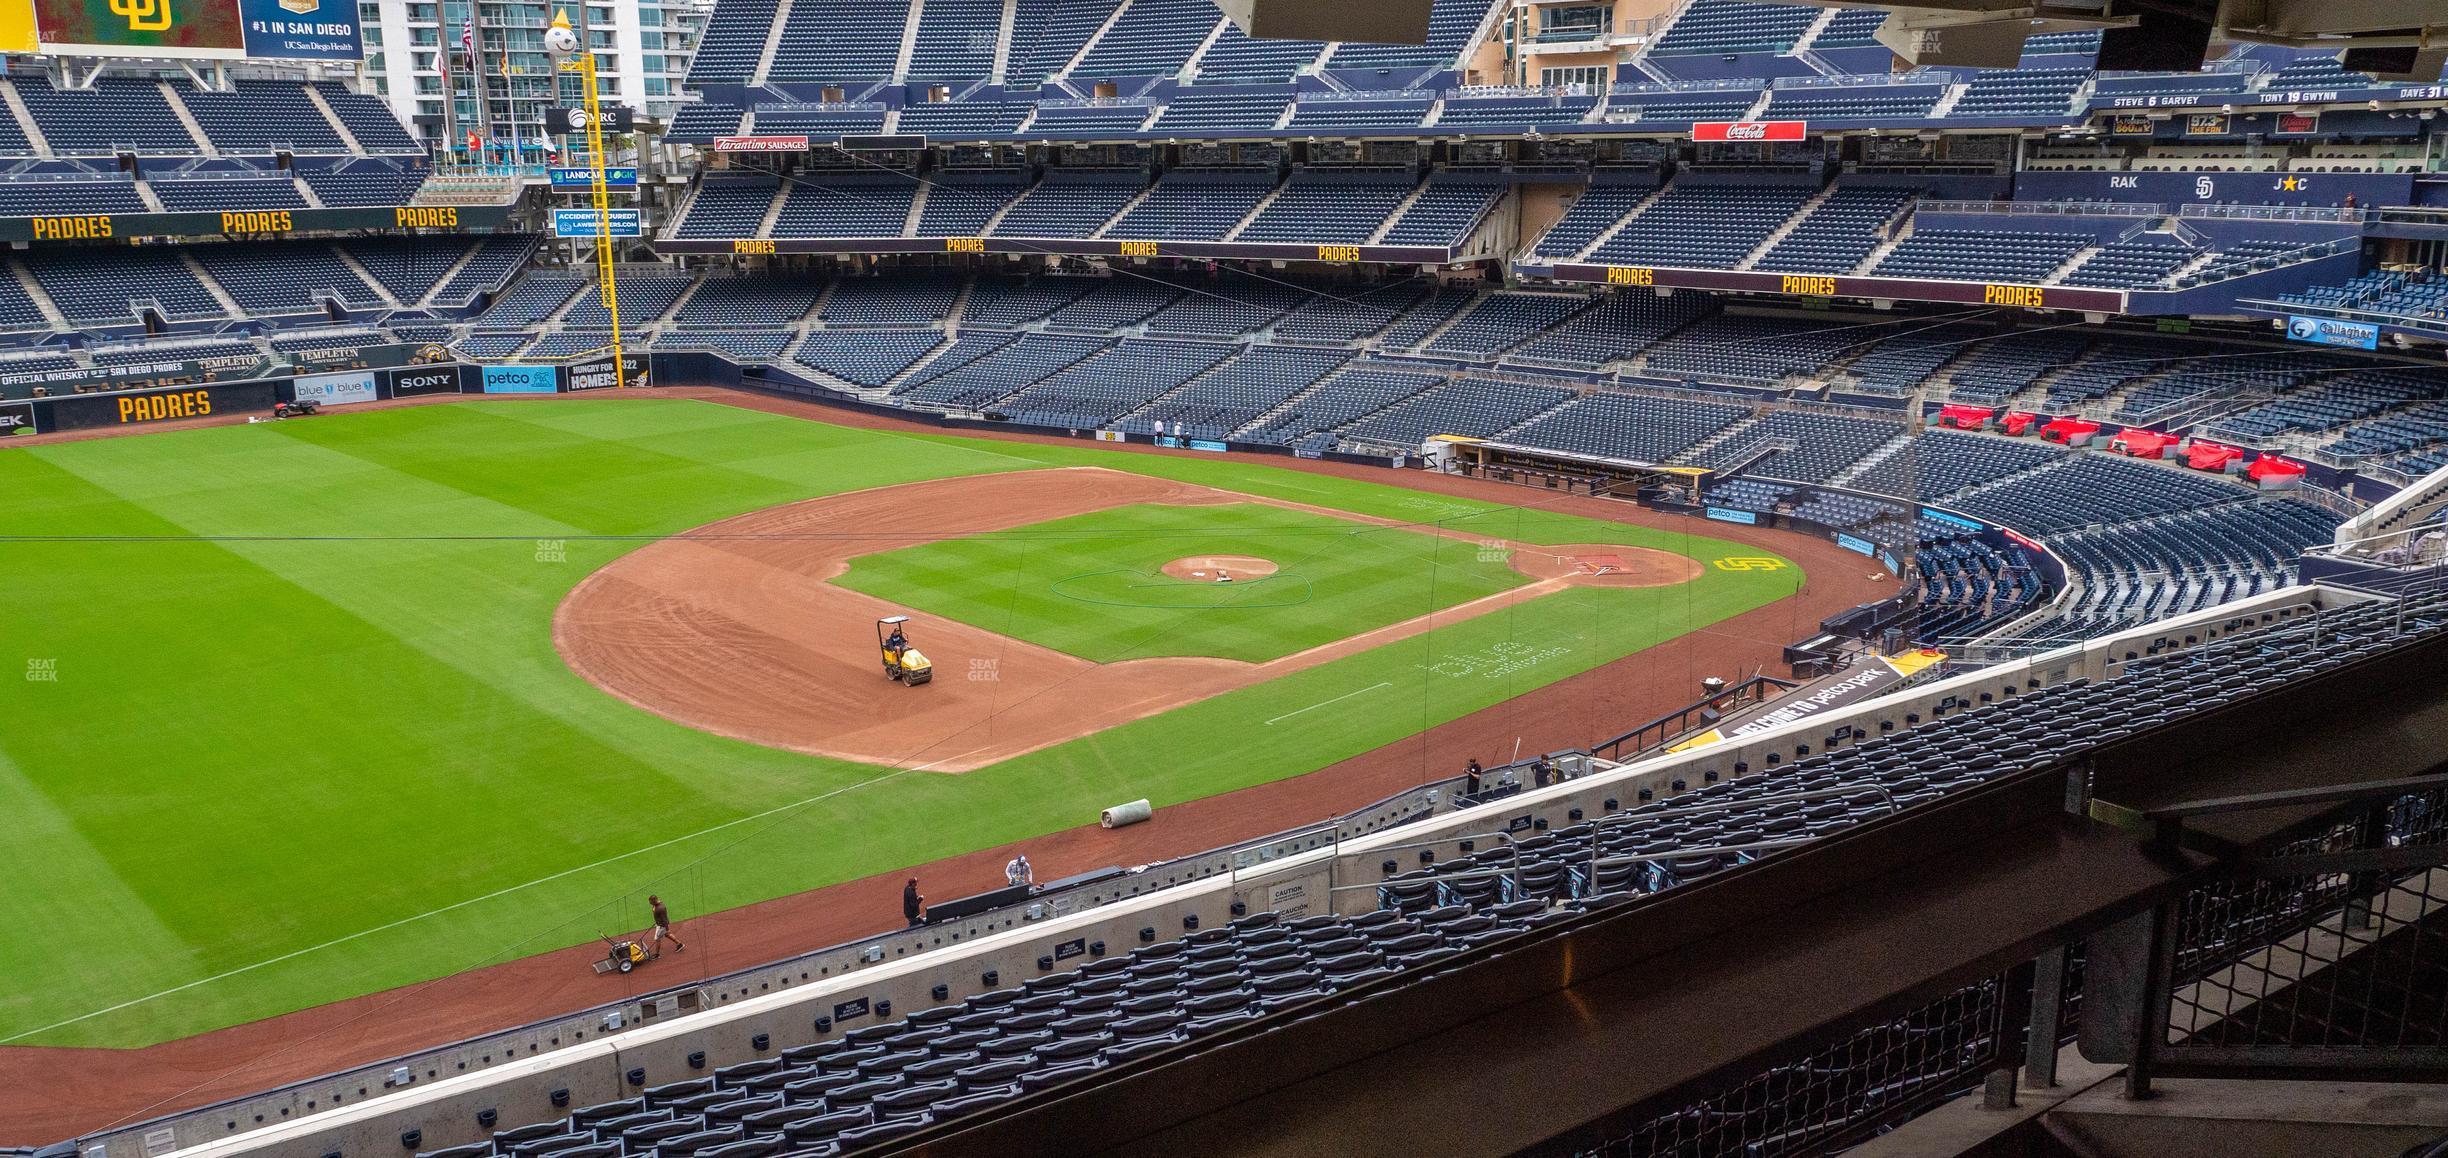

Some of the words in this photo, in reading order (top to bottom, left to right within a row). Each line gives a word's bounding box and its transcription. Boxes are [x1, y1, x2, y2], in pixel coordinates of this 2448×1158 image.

[253, 21, 268, 33] #1
[272, 22, 285, 34] IN
[288, 22, 313, 35] SAN
[316, 23, 351, 36] DIEGO
[284, 41, 296, 49] UC
[296, 41, 310, 49] San
[311, 42, 330, 51] Diego
[330, 42, 353, 51] Health
[2259, 93, 2284, 102] TONY
[2287, 91, 2301, 102] 19
[2302, 91, 2337, 101] GWYNN
[2400, 88, 2425, 98] DAVE
[2427, 86, 2440, 98] 31
[2114, 98, 2144, 106] STEVE
[2148, 96, 2156, 106] 6
[2161, 96, 2199, 105] GARVEY
[2191, 115, 2216, 126] 97.3
[1726, 123, 1768, 139] Coca-Cola
[717, 138, 766, 150] Tarantino
[768, 141, 807, 149] SAUSAGES
[565, 171, 606, 180] LANDCAR
[2110, 176, 2138, 188] RAK
[222, 211, 292, 233] PADRES
[396, 207, 457, 227] PADRES
[33, 217, 112, 239] PADRES
[734, 239, 775, 254] PADRES
[947, 238, 984, 252] PADRES
[1121, 241, 1157, 256] PADRES
[1318, 245, 1360, 261] PADRES
[1608, 267, 1653, 285] PADRES
[1782, 275, 1835, 295] PADRES
[1985, 285, 2042, 307] PADRES
[2320, 322, 2373, 339] Gallagher
[301, 348, 359, 362] TEMPLETON
[199, 356, 261, 371] TEMPLETON
[572, 364, 600, 374] HUNGRY
[600, 363, 613, 372] FOR
[2, 373, 44, 385] OFFICIAL
[46, 370, 89, 383] WHISKEY
[110, 366, 127, 376] SAN
[128, 365, 152, 375] DIEGO
[153, 362, 183, 373] PADRES
[487, 372, 529, 387] petco
[571, 372, 617, 389] HOMERS
[337, 382, 362, 392] blue
[401, 375, 451, 388] SONY
[297, 386, 323, 396] blue
[118, 390, 211, 423] PADRES
[1191, 441, 1209, 449] petco
[1708, 508, 1730, 518] petco
[1839, 535, 1856, 547] petco
[1731, 705, 1803, 736] WELCOME
[1792, 699, 1819, 713] TO
[1808, 680, 1856, 705] petco
[1850, 668, 1888, 687] park
[1275, 885, 1303, 898] CAUTION
